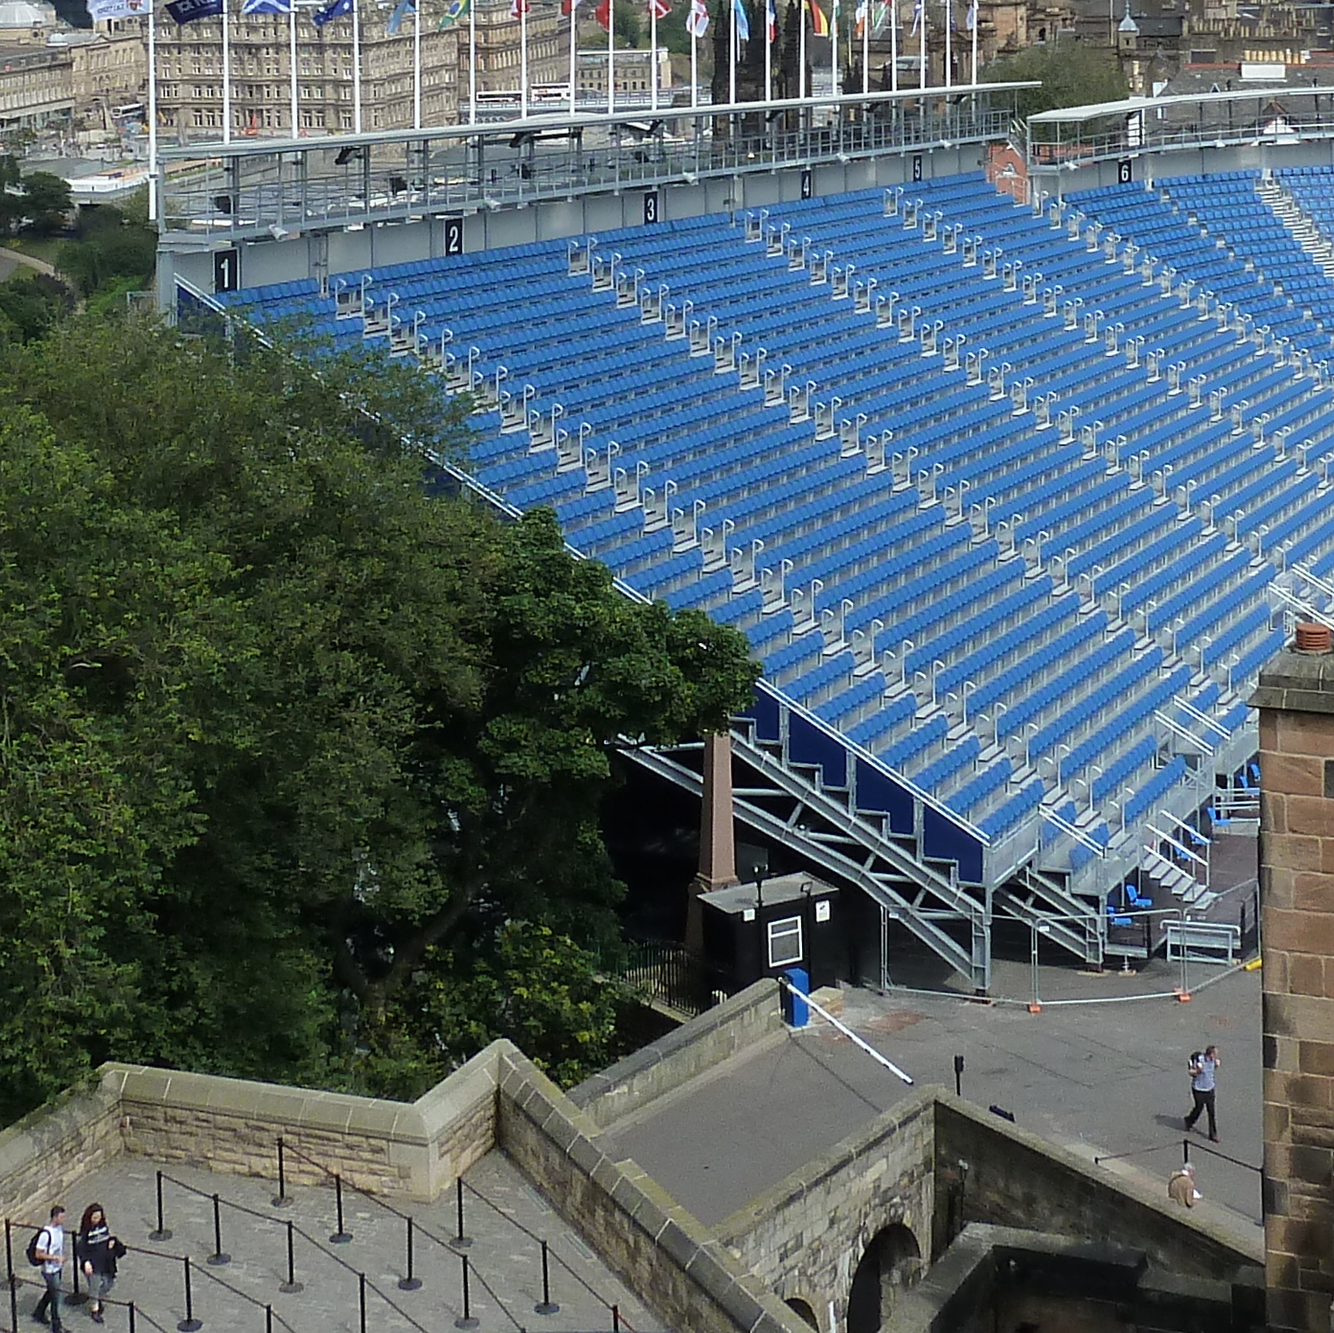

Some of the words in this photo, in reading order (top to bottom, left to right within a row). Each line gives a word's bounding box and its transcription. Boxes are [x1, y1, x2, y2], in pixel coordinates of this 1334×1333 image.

[914, 158, 920, 179] 5
[1121, 164, 1129, 181] 6
[803, 175, 809, 196] 4
[647, 198, 654, 221] 3
[449, 225, 458, 252] 2
[220, 258, 229, 288] 1
